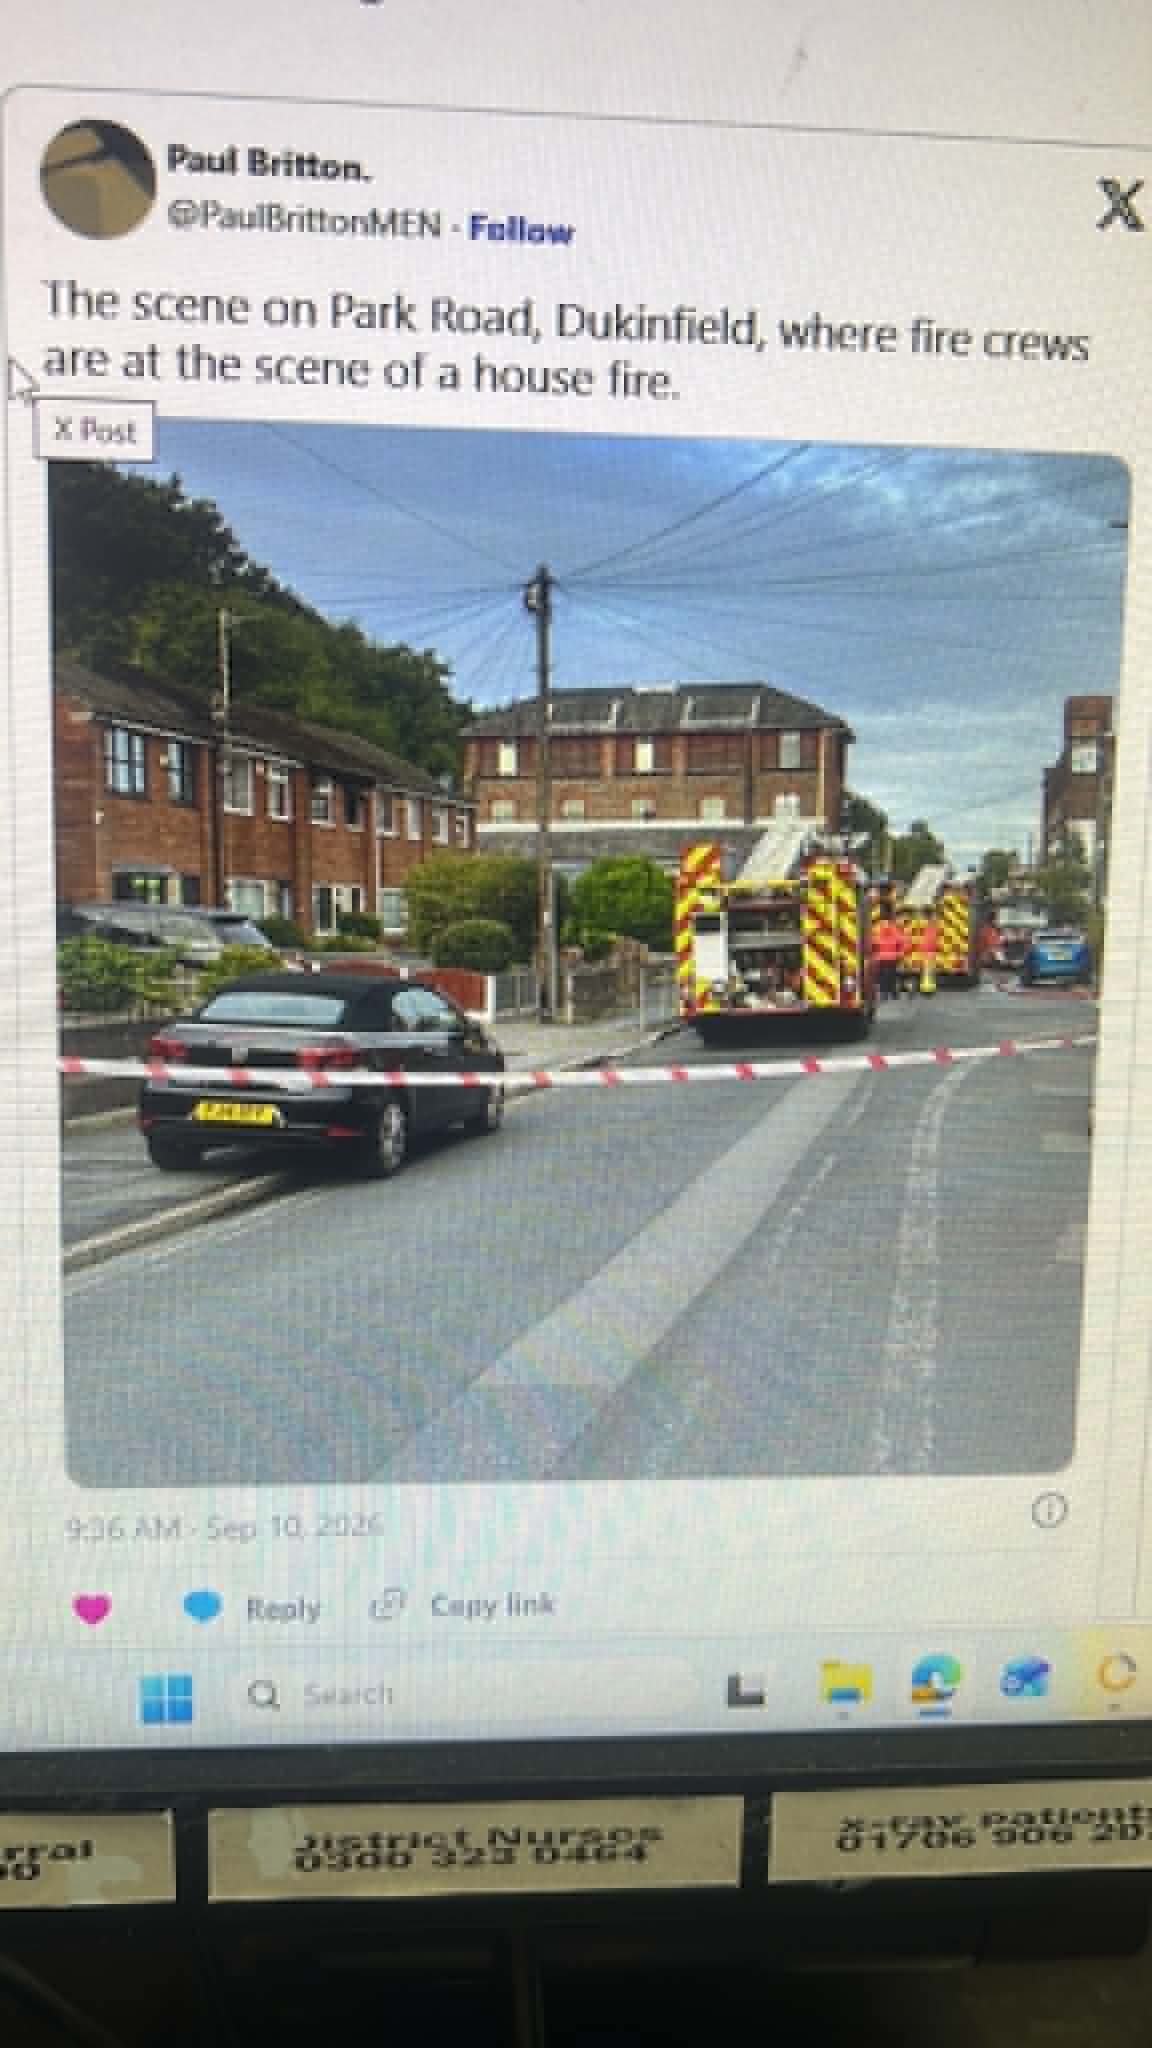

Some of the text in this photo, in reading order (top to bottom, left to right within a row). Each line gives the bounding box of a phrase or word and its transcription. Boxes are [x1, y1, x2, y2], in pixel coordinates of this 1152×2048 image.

[167, 142, 373, 182] Paul Britton.
[1098, 177, 1145, 231] X
[167, 199, 576, 246] @PaulBrittonMEN Follow
[42, 279, 1090, 361] The scene on Park Road, Dukinfield, where fire crews
[43, 344, 681, 401] are at the scene of a house fire.
[54, 417, 137, 444] X Post
[135, 1515, 183, 1540] AM
[207, 1513, 256, 1543] Sep
[247, 1593, 321, 1623] Reply
[431, 1590, 558, 1623] Copy link
[304, 1680, 393, 1706] Search
